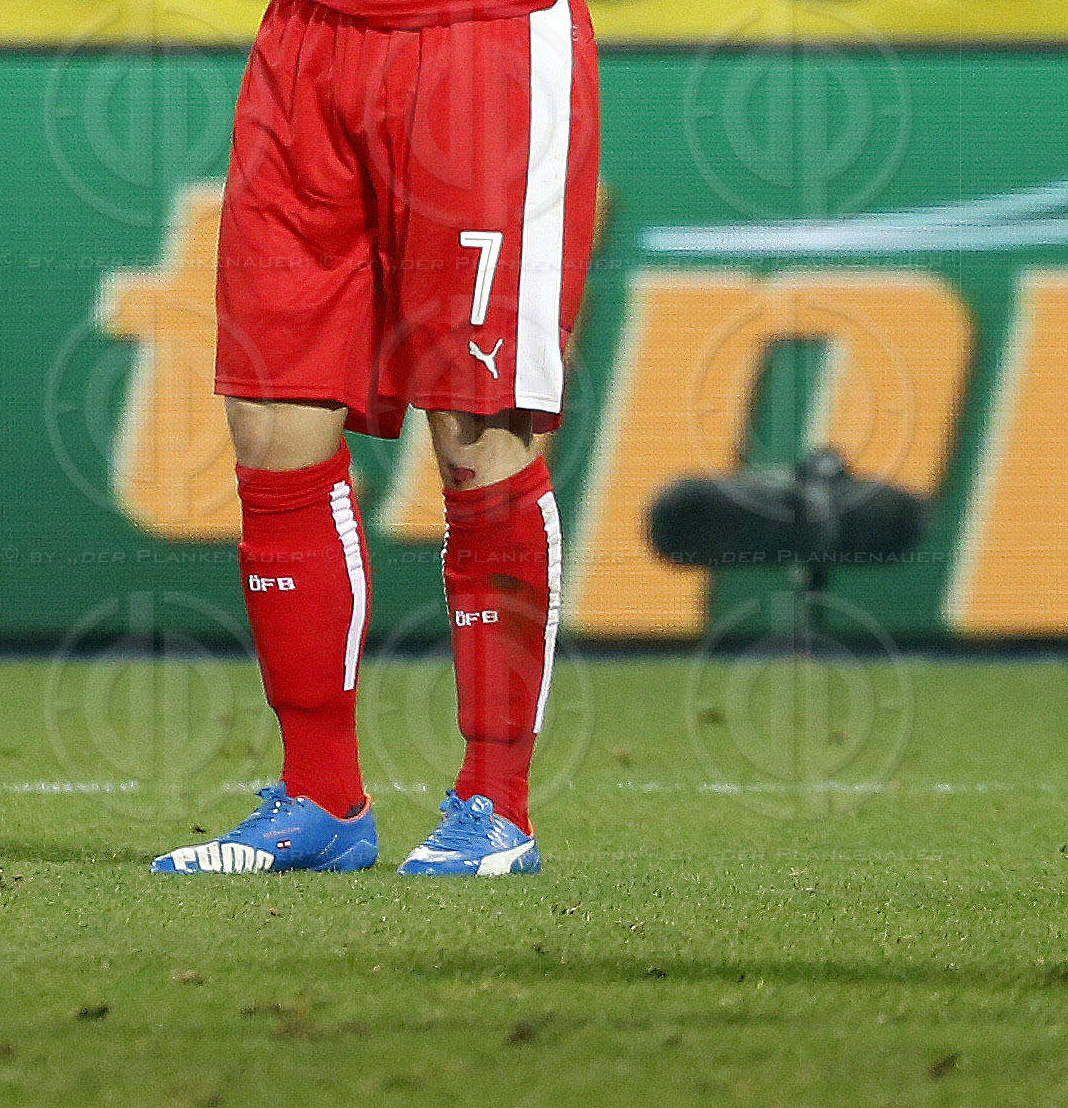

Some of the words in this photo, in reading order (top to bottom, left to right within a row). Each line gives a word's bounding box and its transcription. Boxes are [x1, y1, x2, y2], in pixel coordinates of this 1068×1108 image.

[460, 231, 503, 325] 7
[249, 575, 296, 591] ÖFB
[455, 610, 499, 627] ÖFB
